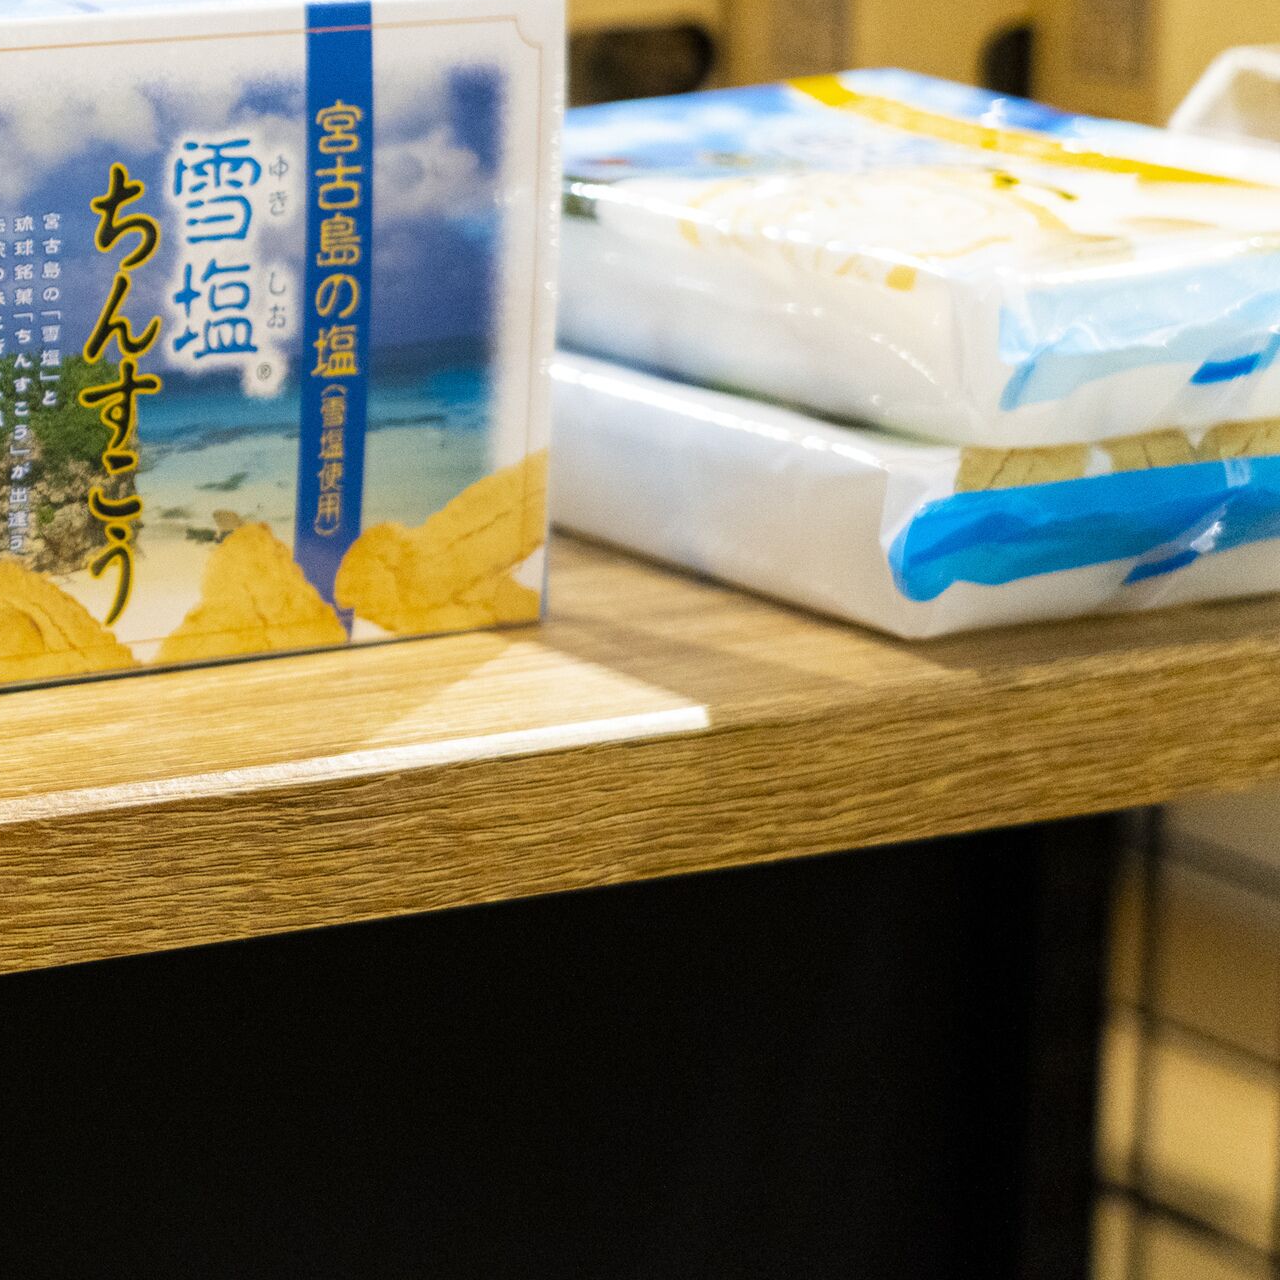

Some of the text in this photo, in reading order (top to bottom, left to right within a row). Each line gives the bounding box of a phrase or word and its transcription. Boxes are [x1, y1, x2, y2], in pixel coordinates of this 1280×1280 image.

[171, 138, 263, 360] 雪塩
[267, 154, 290, 218] ゆき
[267, 269, 288, 331] しお
[78, 162, 163, 628] ちんすこう
